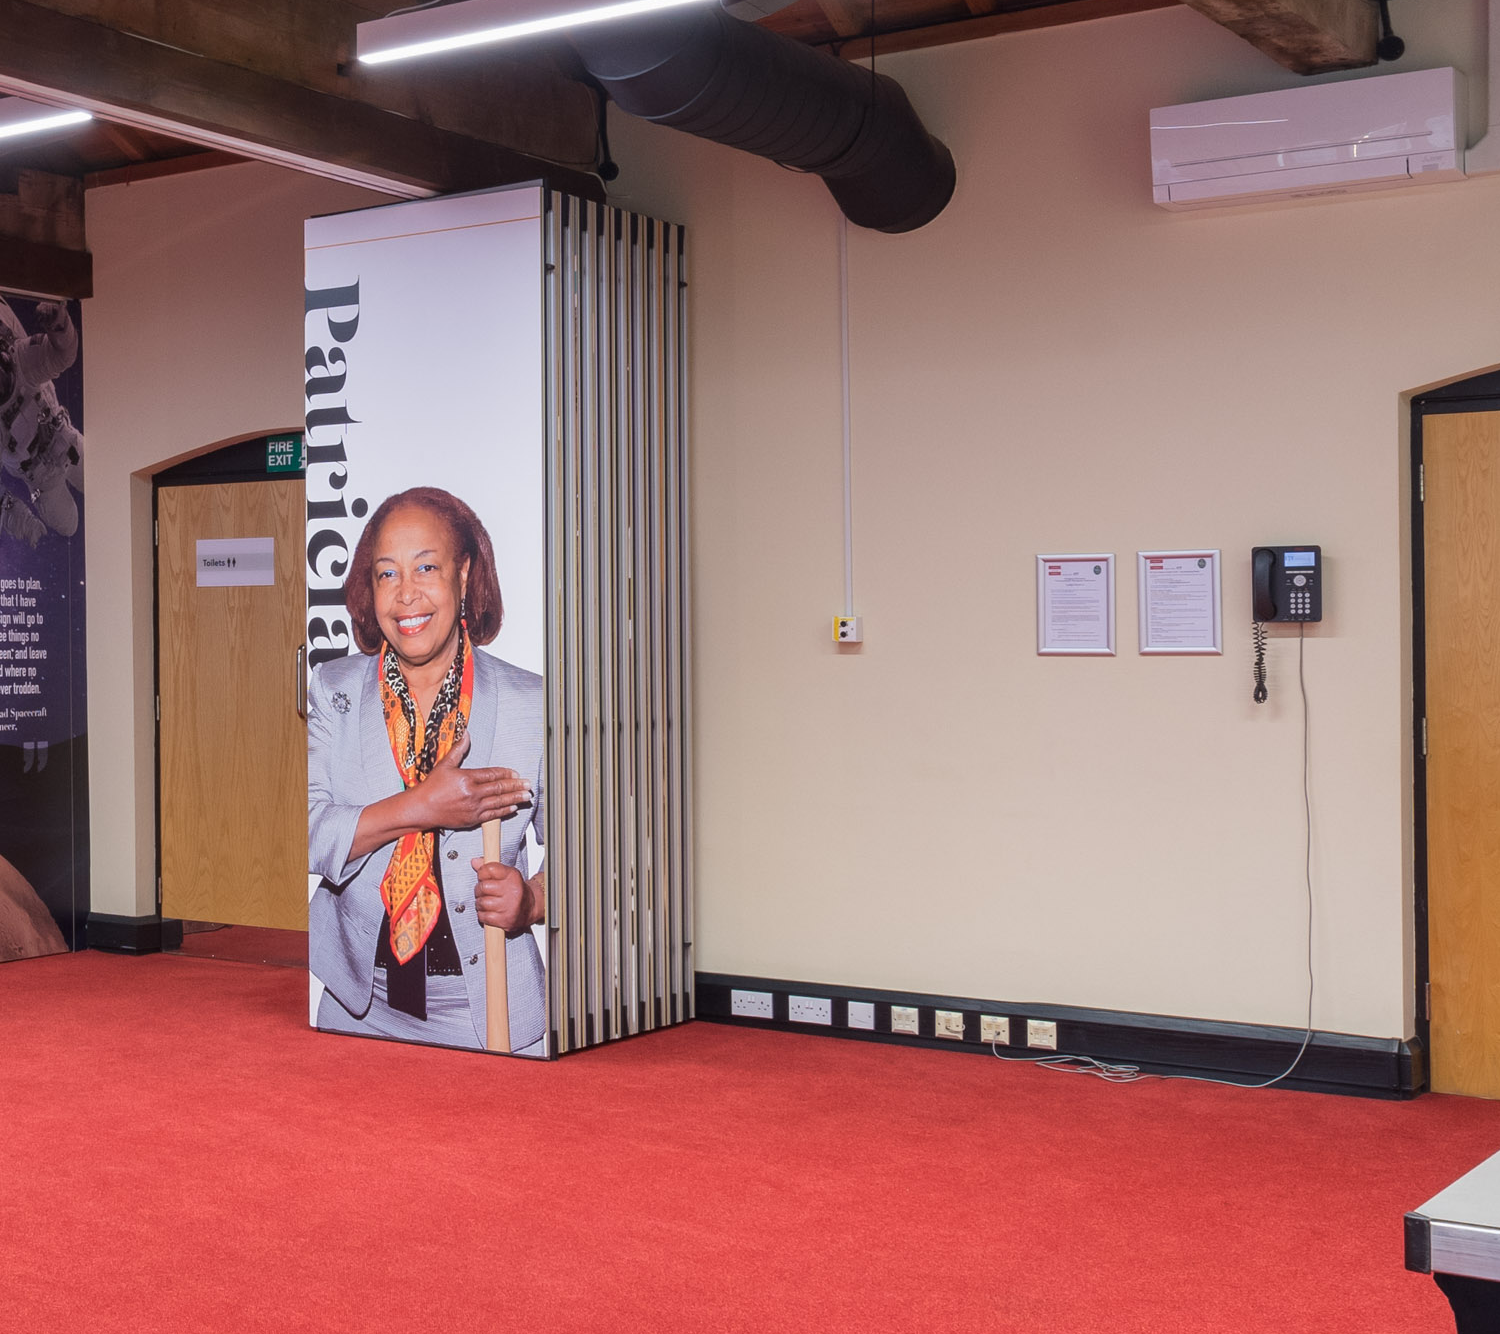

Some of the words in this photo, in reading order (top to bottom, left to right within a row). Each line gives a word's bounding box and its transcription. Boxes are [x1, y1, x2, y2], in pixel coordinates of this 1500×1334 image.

[268, 441, 294, 453] FIRE
[268, 454, 293, 466] EXIT
[203, 559, 225, 567] Toilets
[1, 579, 16, 591] goes
[18, 578, 24, 589] to
[13, 612, 25, 624] will
[27, 615, 35, 627] go
[37, 613, 43, 624] to
